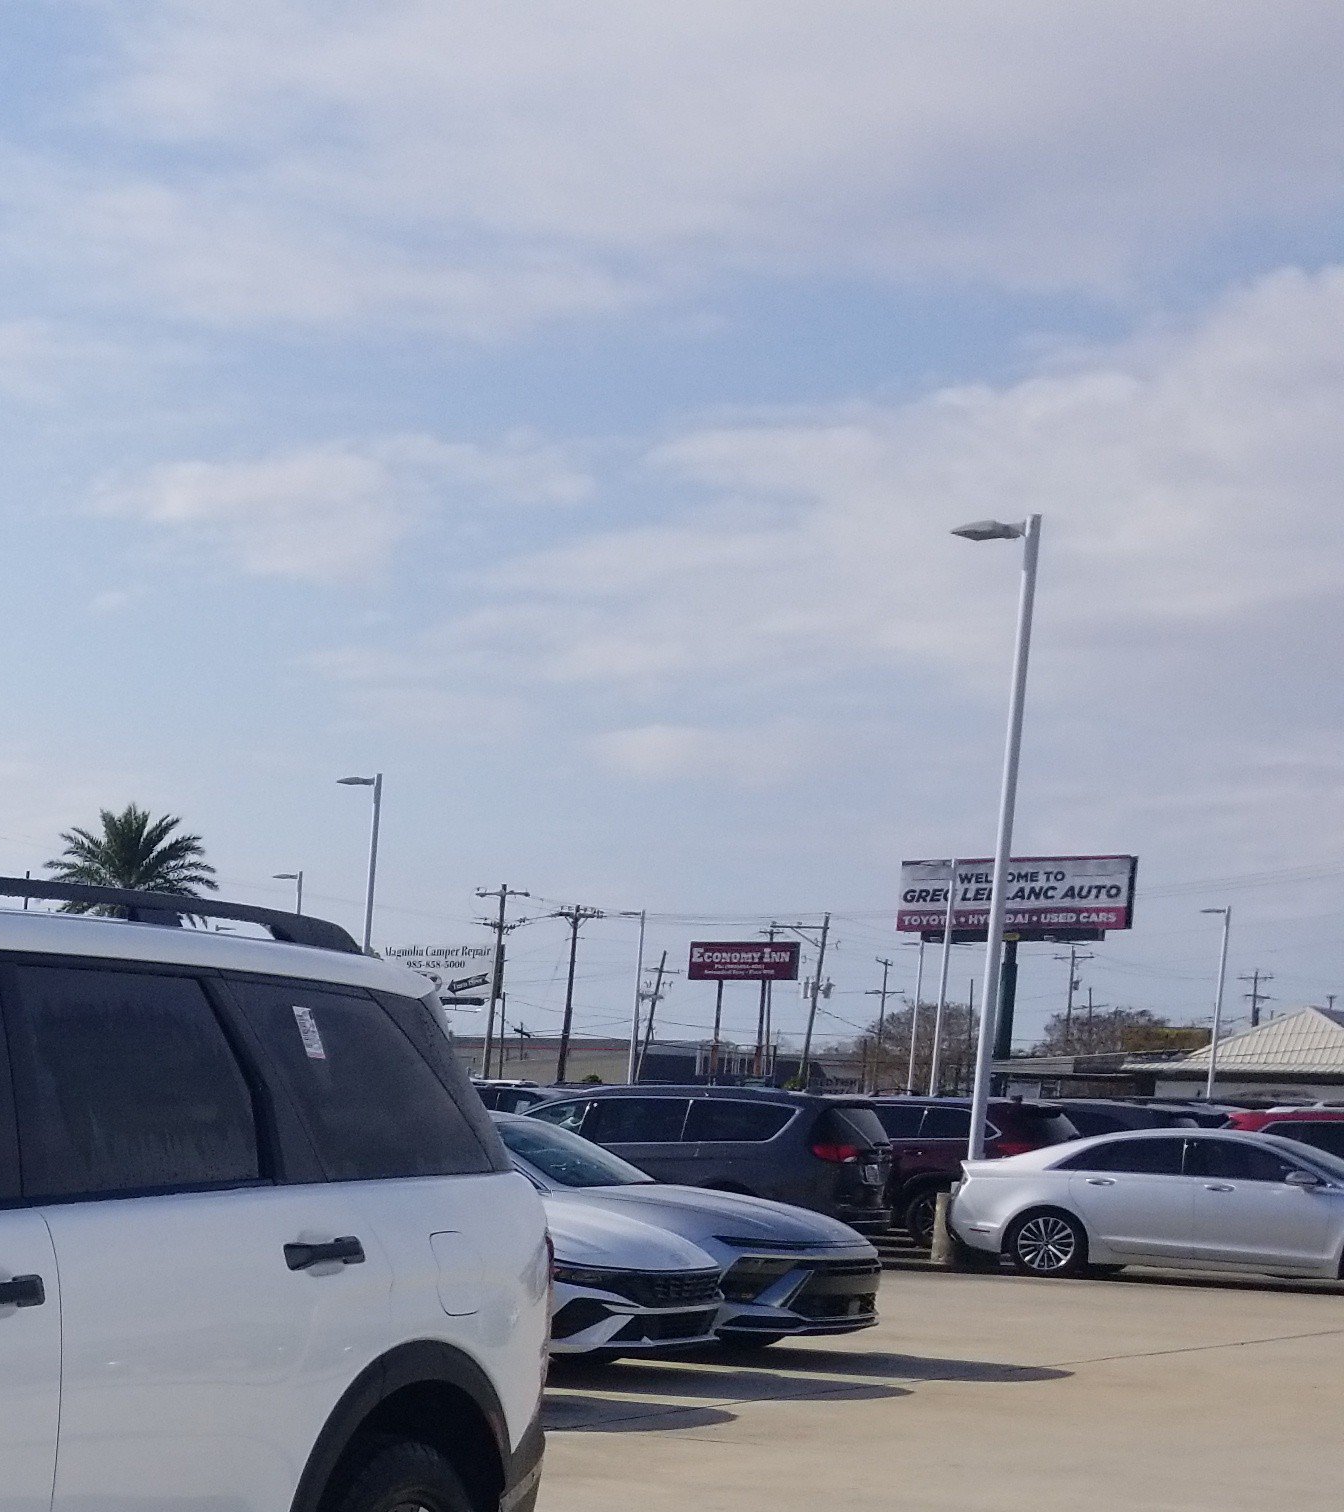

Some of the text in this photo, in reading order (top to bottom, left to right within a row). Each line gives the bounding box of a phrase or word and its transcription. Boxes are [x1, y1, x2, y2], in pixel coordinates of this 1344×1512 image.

[958, 870, 1065, 884] WELOME TO
[961, 886, 1057, 902] LEANC
[1060, 884, 1121, 900] AUTO
[968, 913, 1029, 925] HYDAI
[1041, 912, 1077, 922] USED
[1080, 912, 1117, 922] CARS
[385, 945, 491, 959] Magnolia Camper Repair
